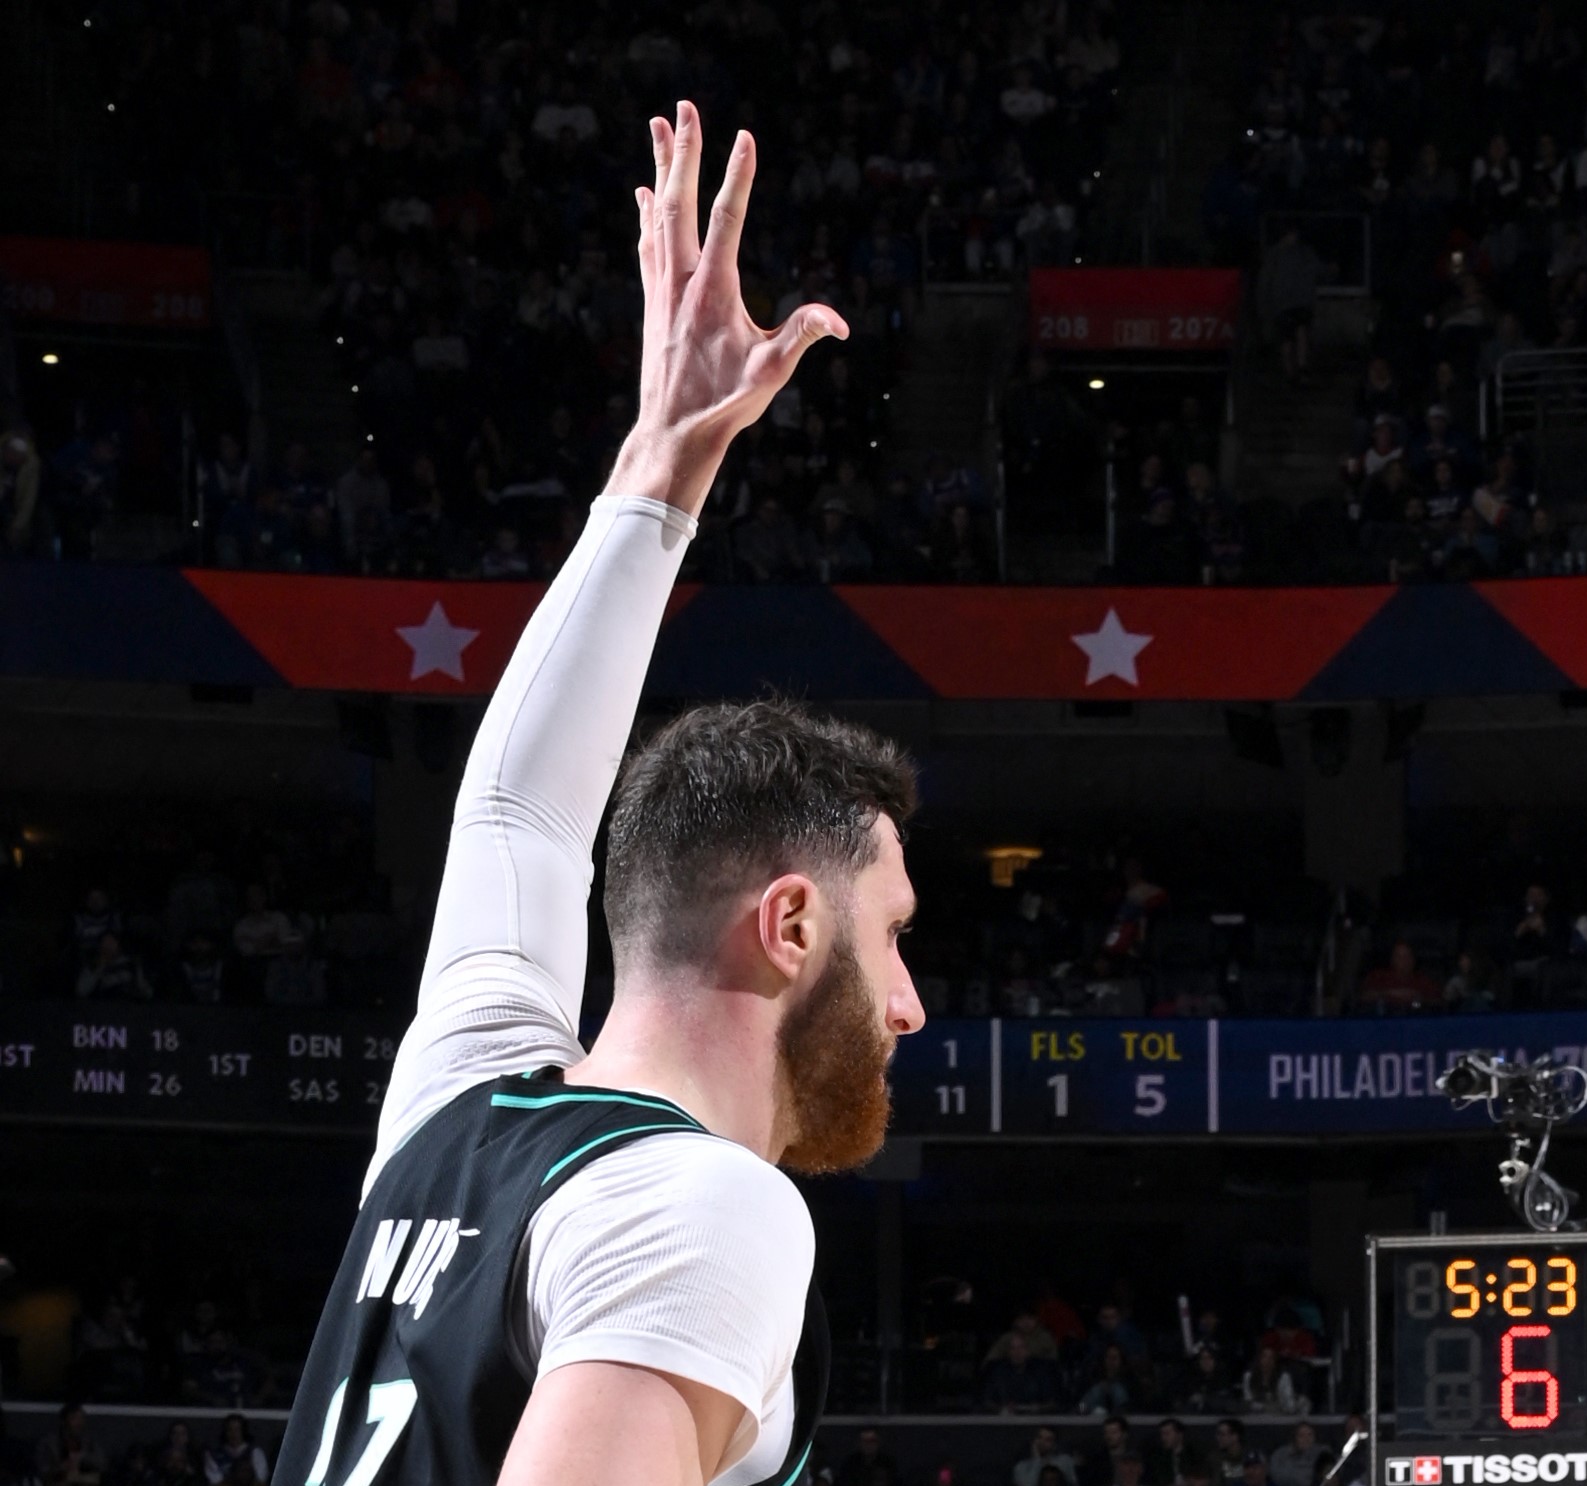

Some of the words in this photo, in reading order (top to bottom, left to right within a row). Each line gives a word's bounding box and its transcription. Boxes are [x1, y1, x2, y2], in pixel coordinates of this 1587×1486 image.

[1039, 315, 1089, 340] 208
[1167, 316, 1235, 340] 207A
[72, 1024, 127, 1049] BKN
[152, 1029, 180, 1052] 18
[288, 1034, 342, 1059] DEN
[1031, 1032, 1086, 1060] FLS
[1120, 1032, 1182, 1061] TOL
[209, 1054, 252, 1077] 1ST
[1269, 1048, 1529, 1099] PHILADEL
[73, 1070, 126, 1094] MIN
[148, 1073, 182, 1097] 26
[289, 1080, 340, 1103] SAS
[365, 1081, 389, 1104] 2
[1047, 1074, 1070, 1117] 1
[1133, 1074, 1167, 1117] 5
[934, 1085, 966, 1114] 11
[1446, 1258, 1577, 1319] 5:23
[1501, 1325, 1559, 1430] 6
